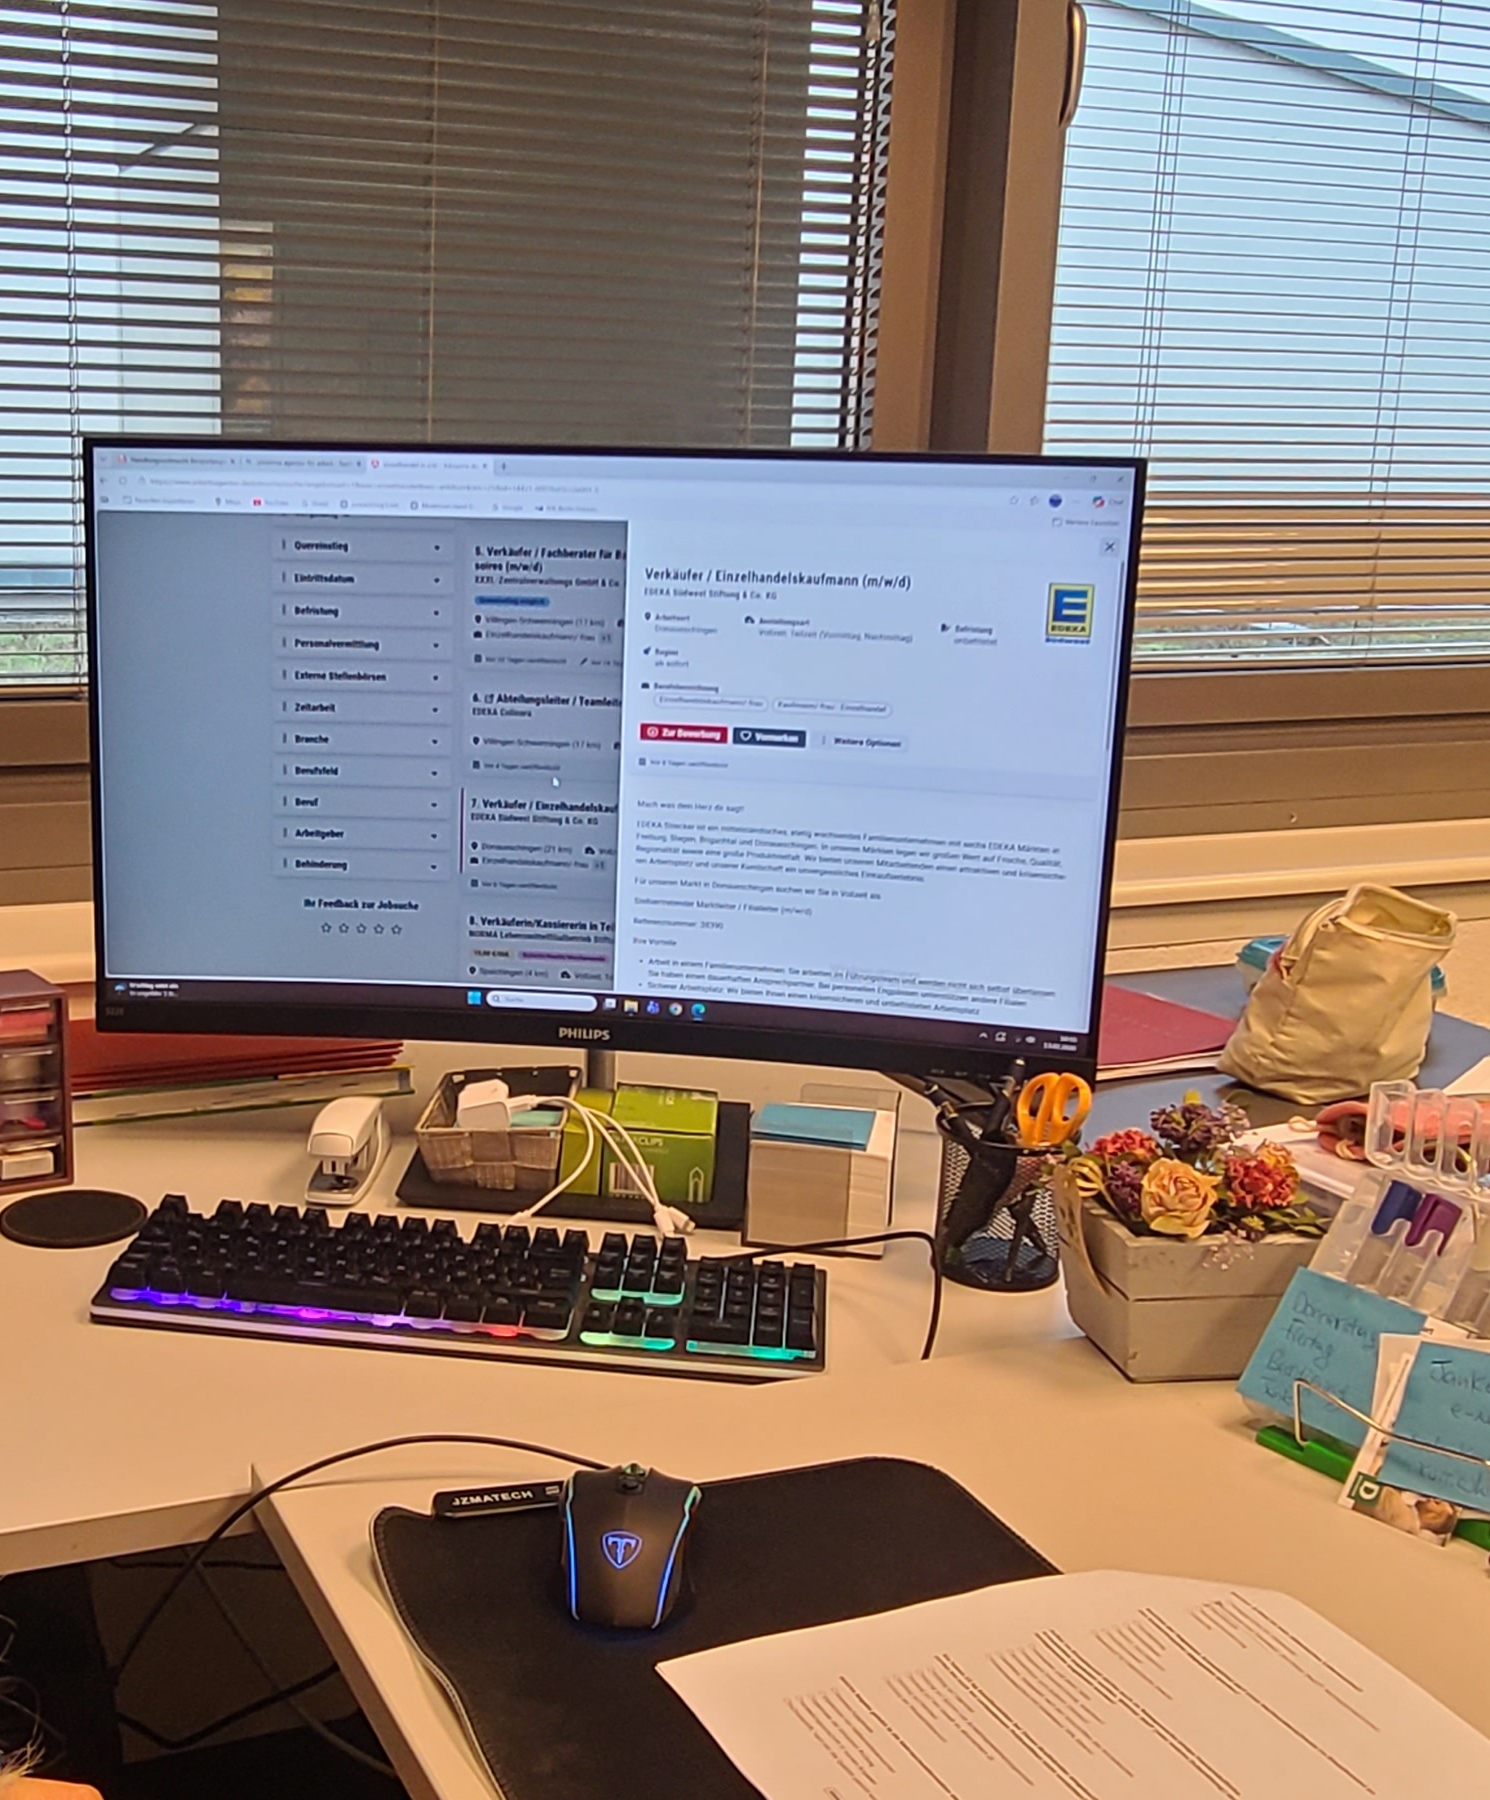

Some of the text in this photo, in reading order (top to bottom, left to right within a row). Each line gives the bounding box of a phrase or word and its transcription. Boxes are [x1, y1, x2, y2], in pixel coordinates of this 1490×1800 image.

[294, 540, 349, 553] Quereinstieg
[486, 546, 532, 558] Verkäufer
[541, 547, 597, 560] Fachberater
[474, 561, 503, 571] soires
[294, 573, 355, 584] Eintrittsdatum
[645, 567, 912, 591] Verkäufer / Einzelhandelskaufmann (m/w/d)
[644, 587, 671, 597] EDEKA
[294, 605, 339, 618] Befristung
[294, 638, 380, 652] Personalvermittlung
[294, 670, 386, 682] Externe Stellenbörsen
[496, 693, 570, 707] Abteilungsleiter
[294, 703, 336, 713] Zeitarbeit
[294, 734, 329, 744] Branche
[294, 766, 339, 776] Berufsfeld
[294, 797, 319, 807] Beruf
[482, 798, 527, 810] Verkäufer
[294, 829, 344, 840] Arbeitgeber
[295, 860, 348, 871] Behinderung
[318, 899, 359, 909] Feedback
[361, 901, 376, 910] zur
[377, 900, 420, 911] Jobsuche
[480, 916, 588, 930] Verkäuferin/Kassiererin
[590, 921, 598, 930] in
[559, 1027, 610, 1041] PHILIPS
[452, 1490, 533, 1506] JZMATECH
